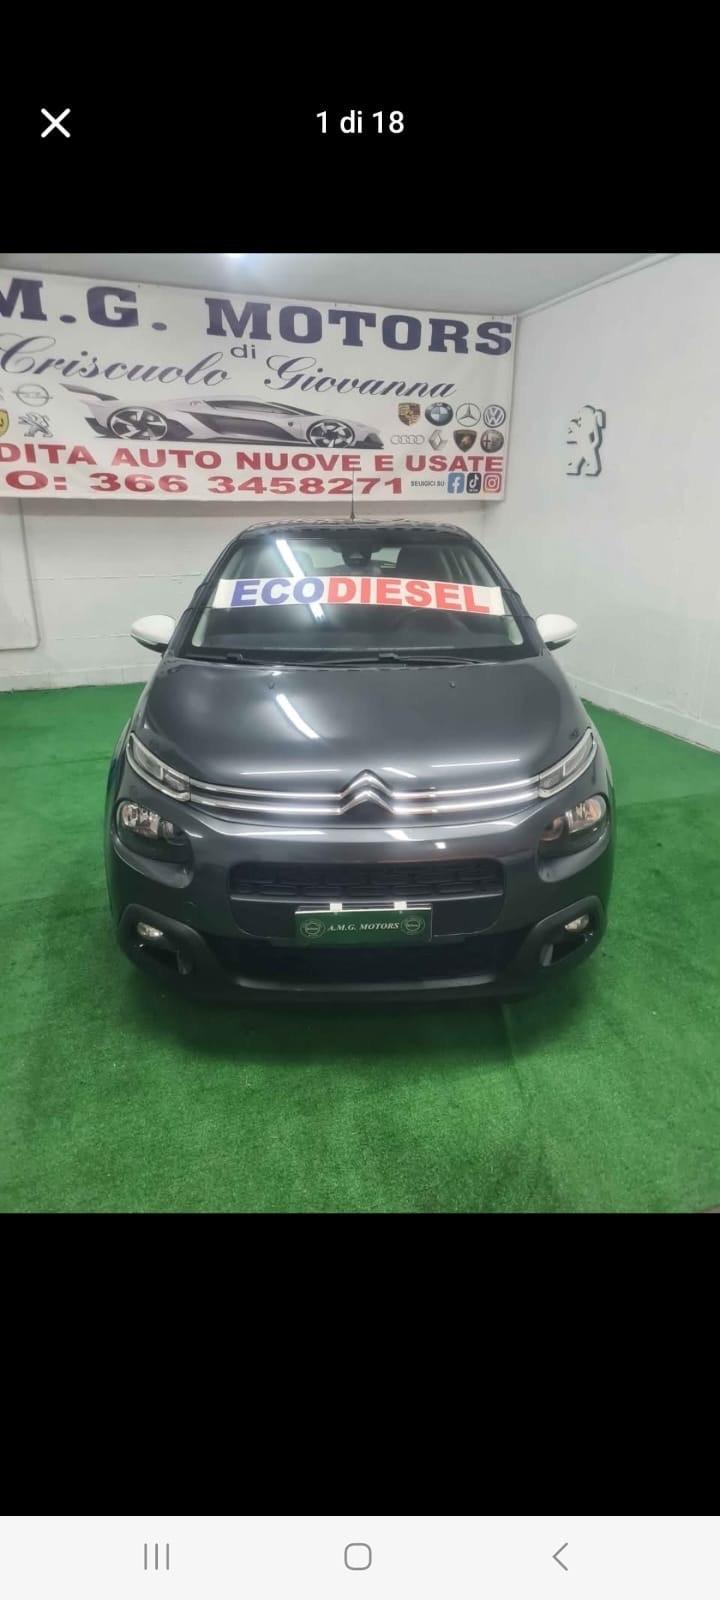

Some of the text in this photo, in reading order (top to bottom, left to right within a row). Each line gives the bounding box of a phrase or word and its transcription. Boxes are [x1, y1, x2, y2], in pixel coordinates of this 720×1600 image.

[205, 297, 512, 355] MOTORS
[0, 332, 456, 398] Criscuolo Giovanna
[230, 344, 256, 359] di
[0, 442, 504, 473] DITA AUTO NUOVE E USATE
[89, 472, 189, 493] 366
[208, 475, 403, 495] 3458271
[230, 577, 490, 614] ECODIESEL
[327, 923, 357, 932] A.M.G.
[359, 922, 399, 931] MOTORS
